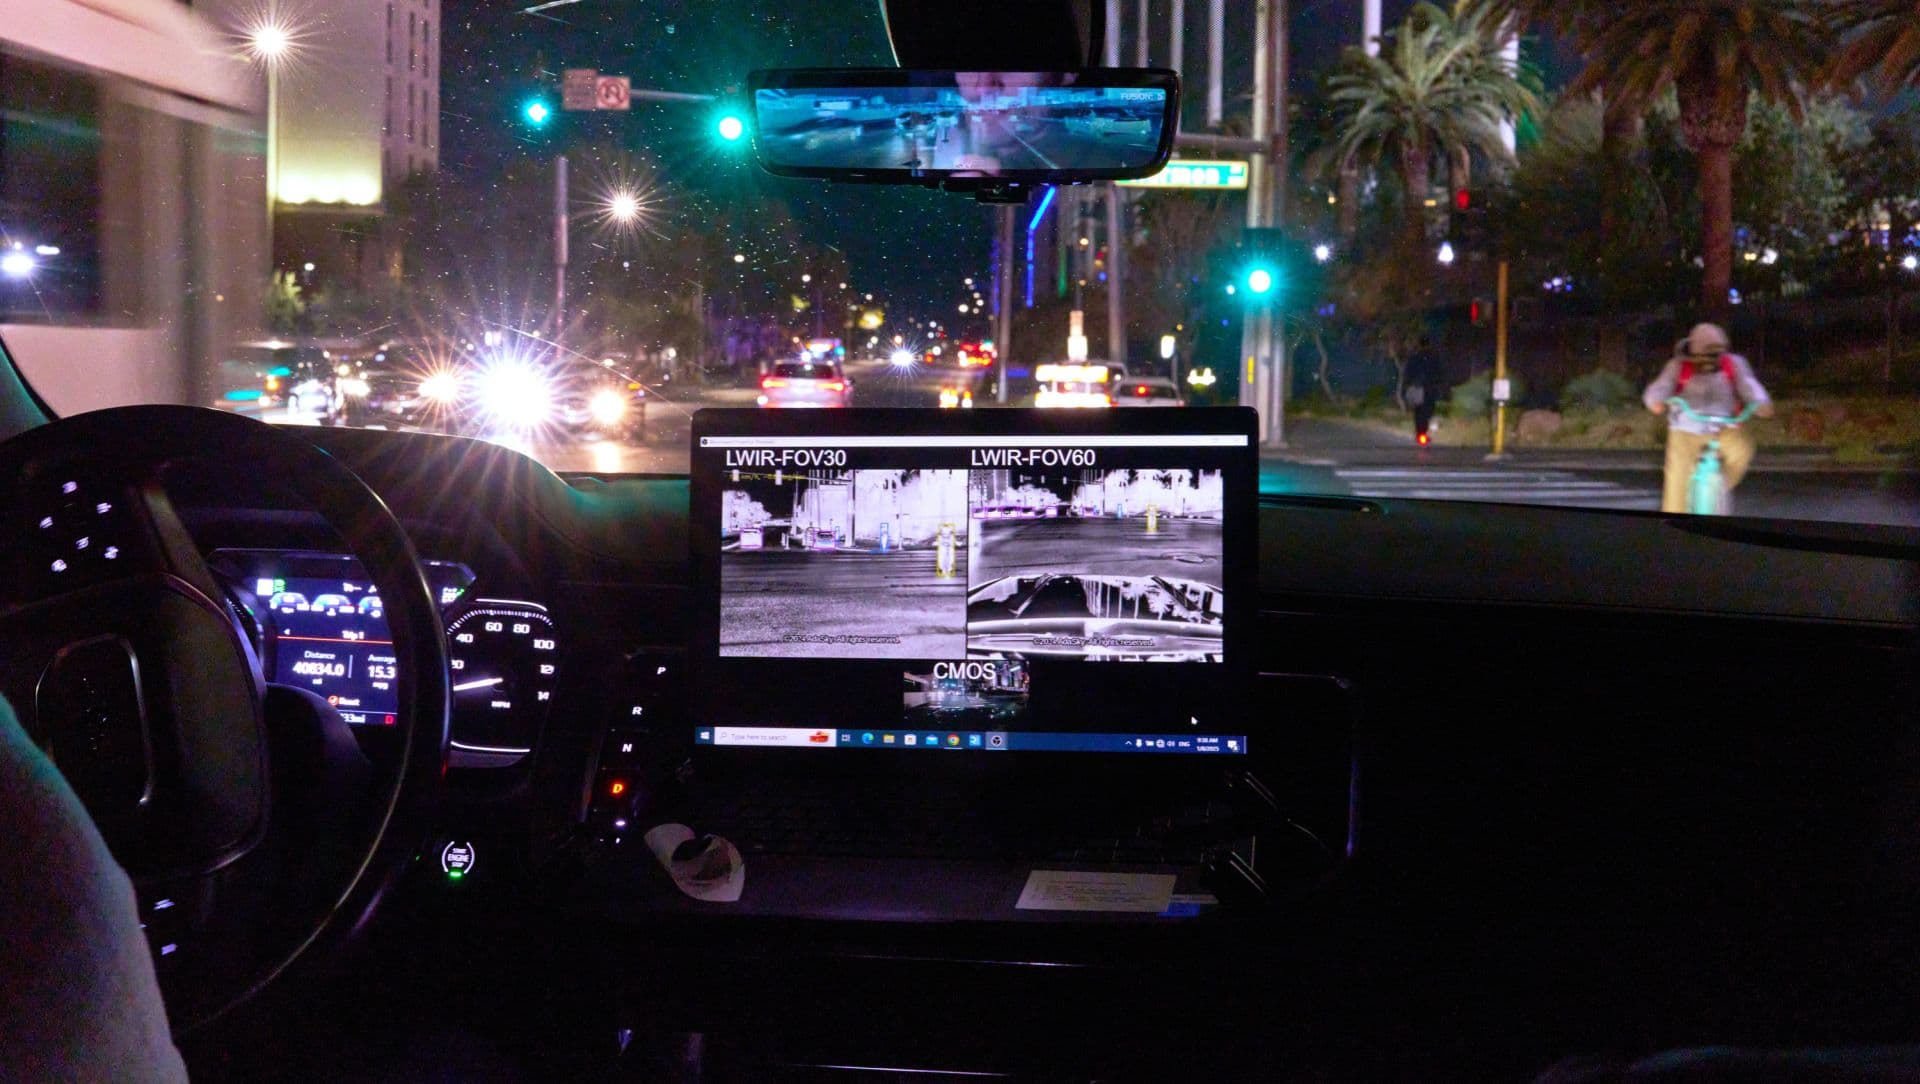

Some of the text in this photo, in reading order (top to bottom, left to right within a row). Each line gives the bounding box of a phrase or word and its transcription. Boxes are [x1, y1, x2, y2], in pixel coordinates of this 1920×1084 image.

[726, 449, 847, 466] LWIR-FOV30
[971, 448, 1096, 466] LWIR-FOV60
[485, 622, 503, 632] 60
[513, 624, 530, 633] 80
[456, 633, 473, 643] 40
[533, 639, 555, 650] 100
[304, 651, 336, 660] Distance
[368, 665, 396, 679] 15.3
[933, 662, 997, 680] CMOS
[632, 707, 642, 715] R
[622, 744, 632, 752] N
[612, 784, 623, 793] D
[447, 854, 470, 862] ENGINE
